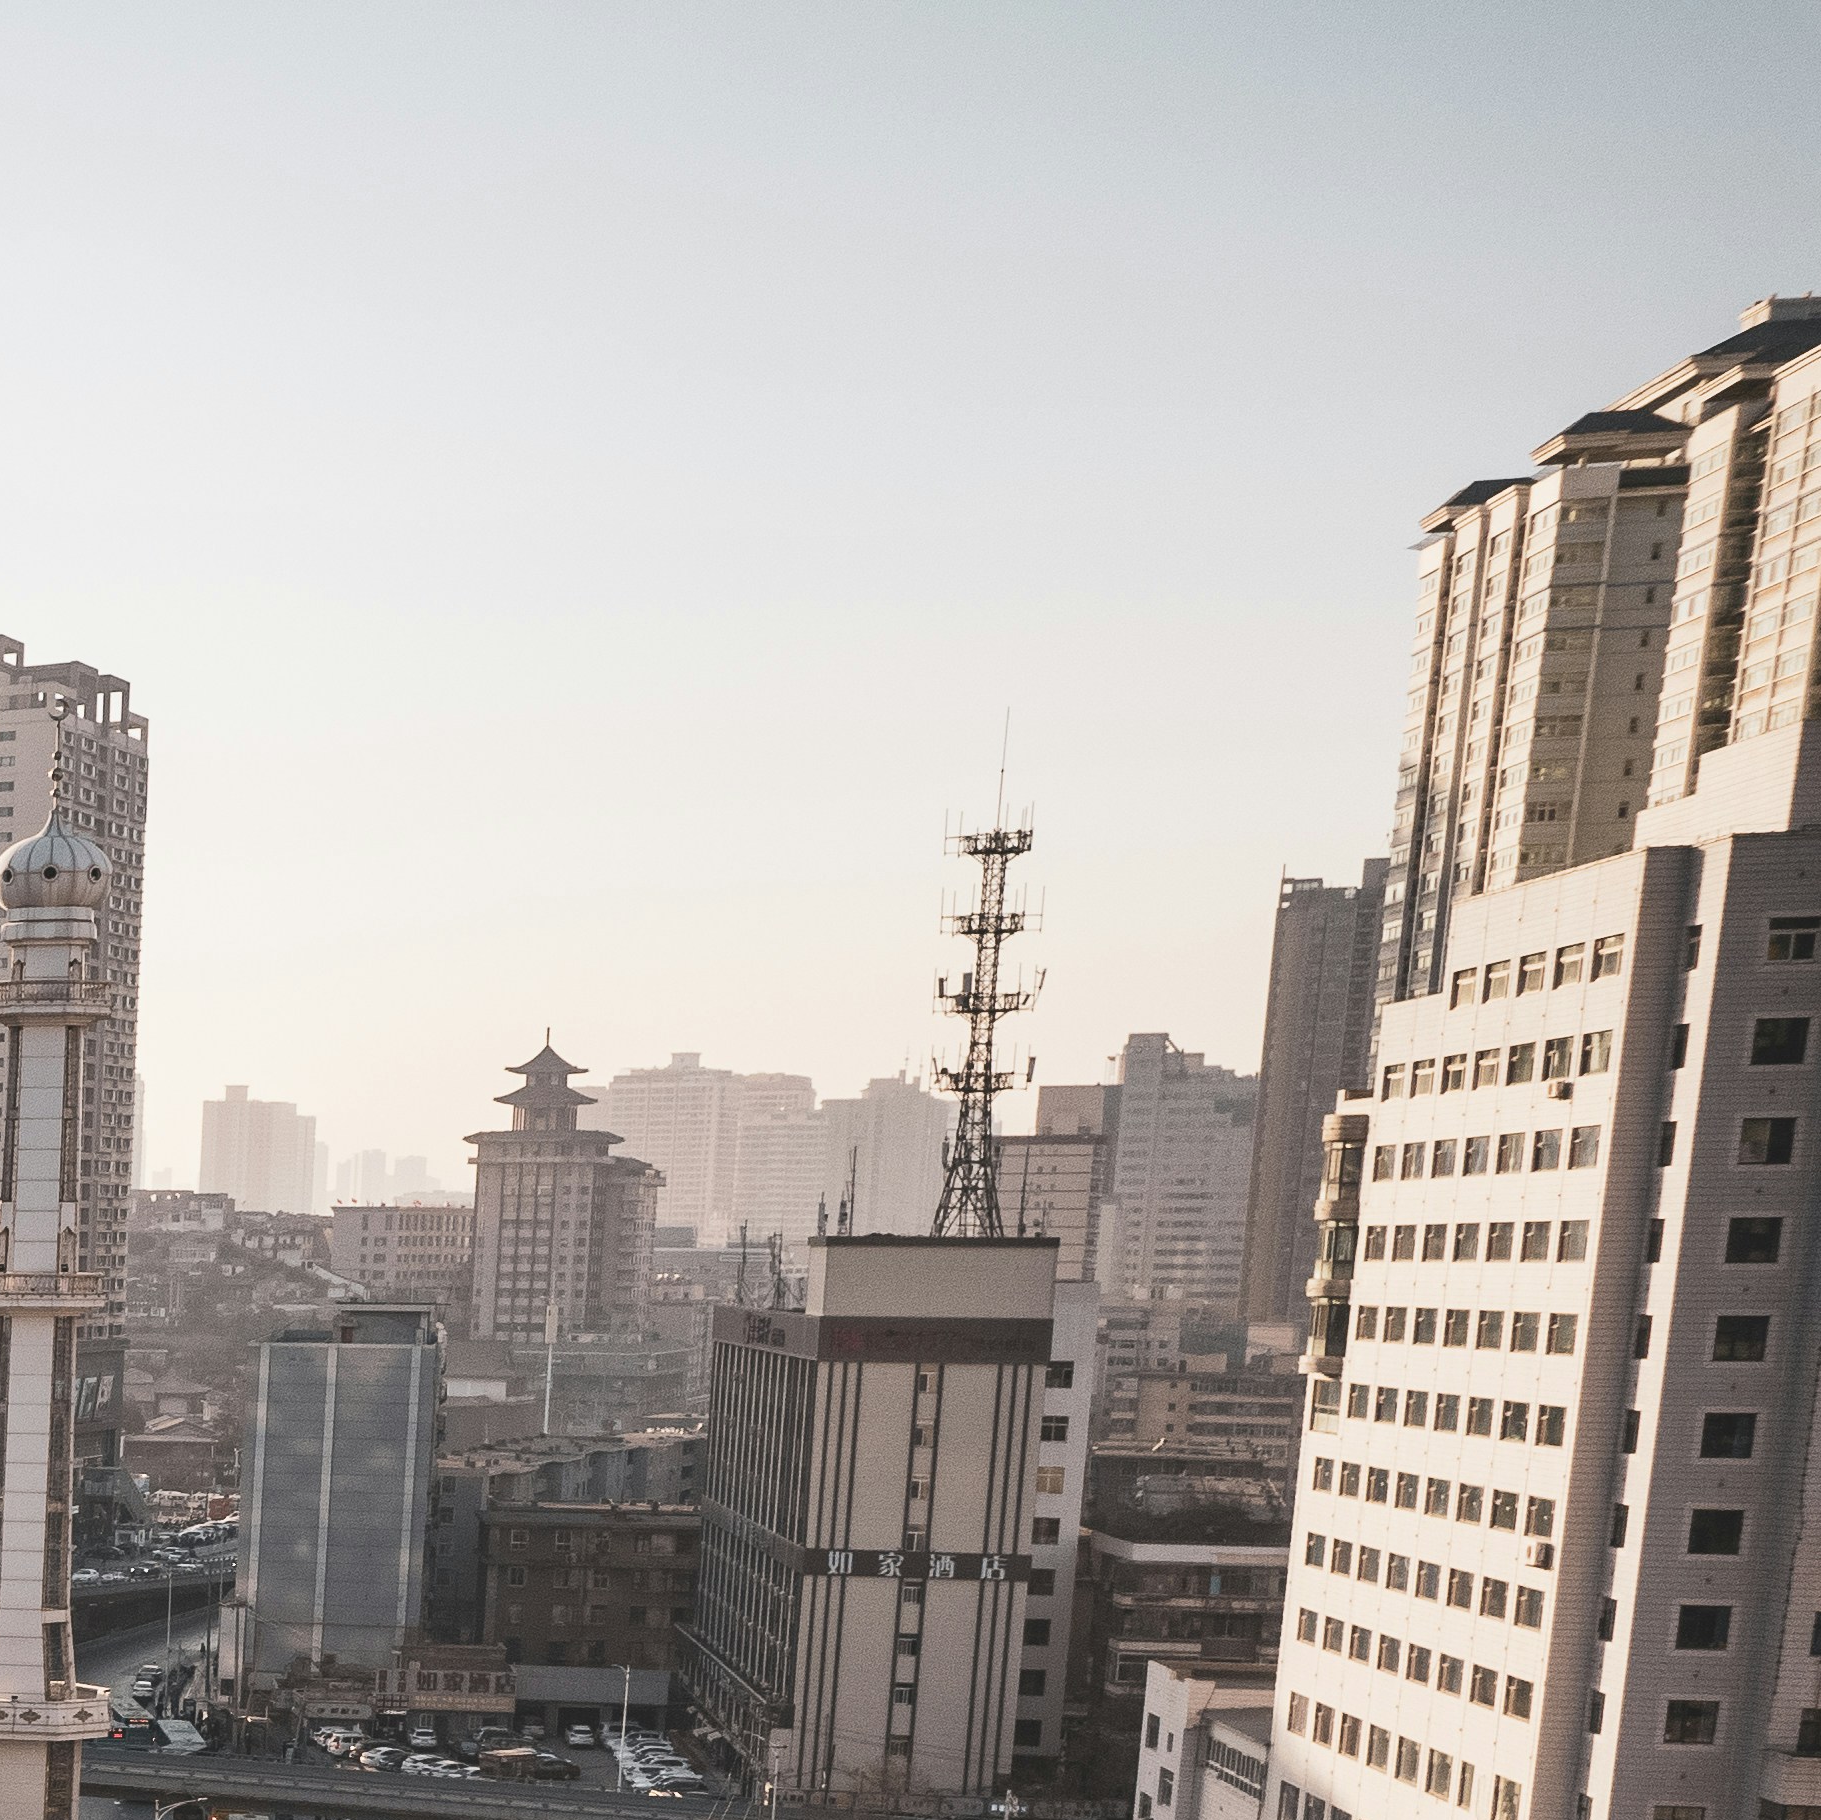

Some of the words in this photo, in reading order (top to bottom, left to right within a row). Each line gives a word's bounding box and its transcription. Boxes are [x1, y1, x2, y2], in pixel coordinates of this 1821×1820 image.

[827, 1549, 1008, 1580] 如家酒店
[416, 1670, 516, 1693] 如家酒店
